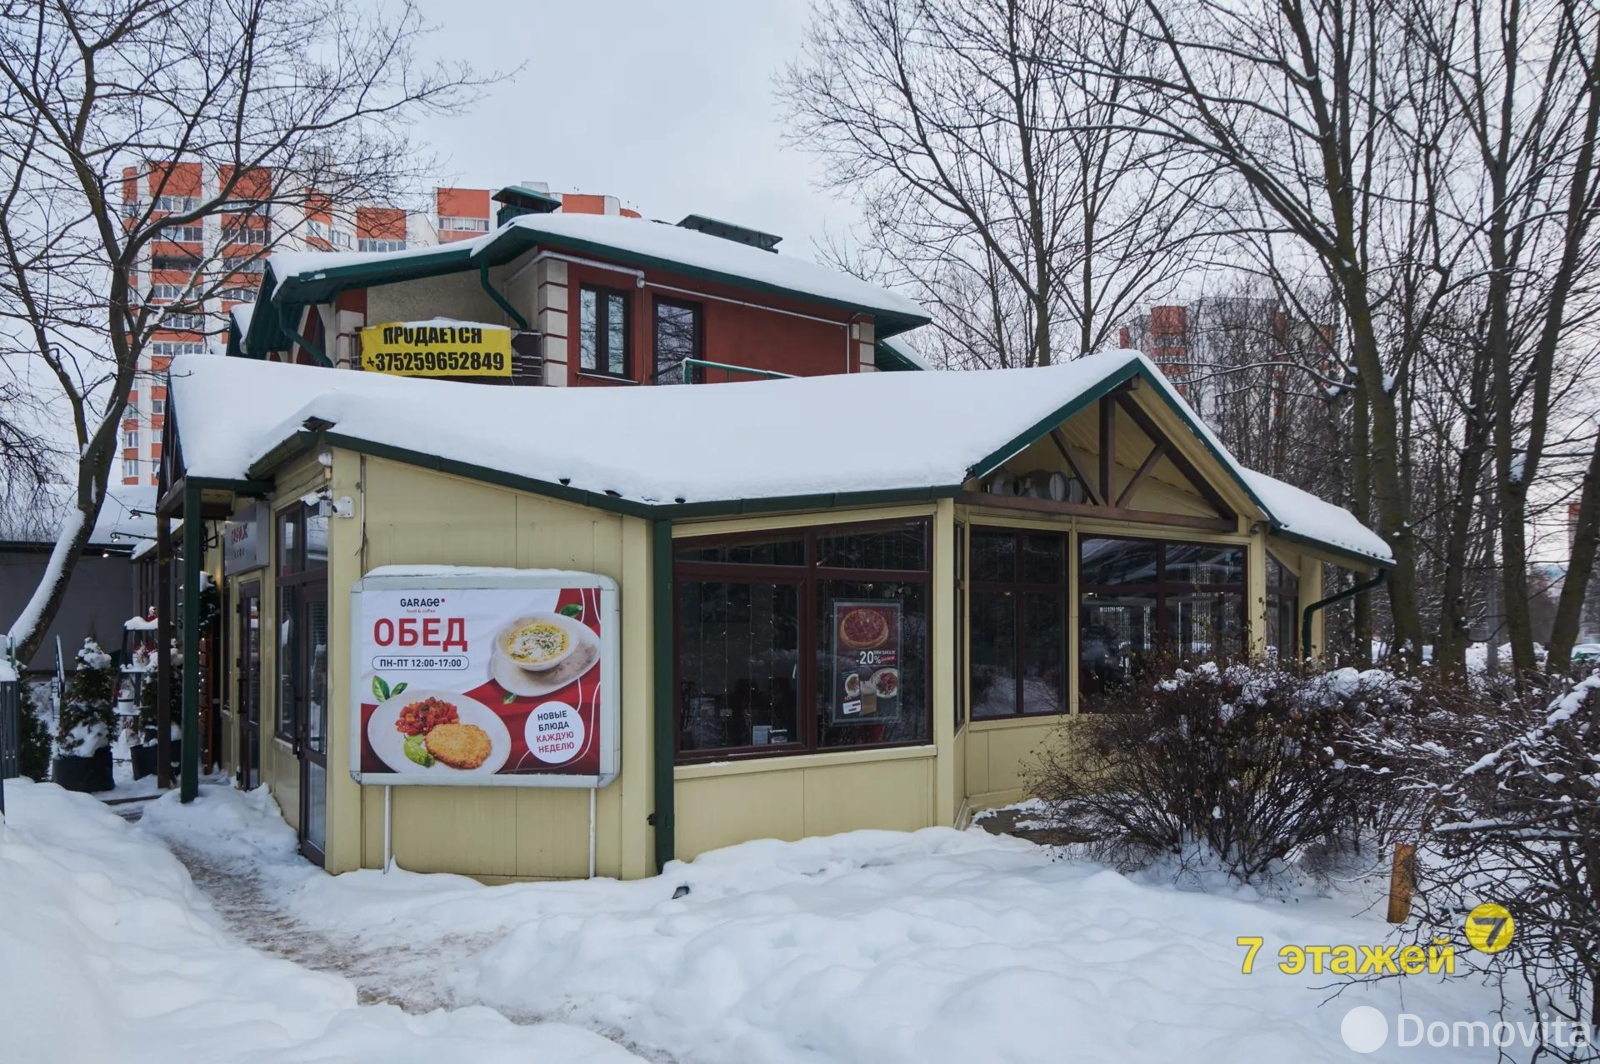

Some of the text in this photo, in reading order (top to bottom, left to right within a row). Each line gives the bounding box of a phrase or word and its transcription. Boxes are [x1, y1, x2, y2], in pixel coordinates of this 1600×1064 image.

[383, 327, 482, 347] ПРОДАЕТСЯ
[366, 352, 505, 371] +375259652849
[374, 618, 468, 652] ОБЕД
[380, 659, 462, 667] ПН-ПТ 12:00-17:00
[537, 710, 567, 721] НОВЫЕ
[538, 721, 569, 732] БЛЮДА
[536, 731, 574, 743] КАЖДУЮ
[538, 742, 575, 753] НЕДЕЛЮ
